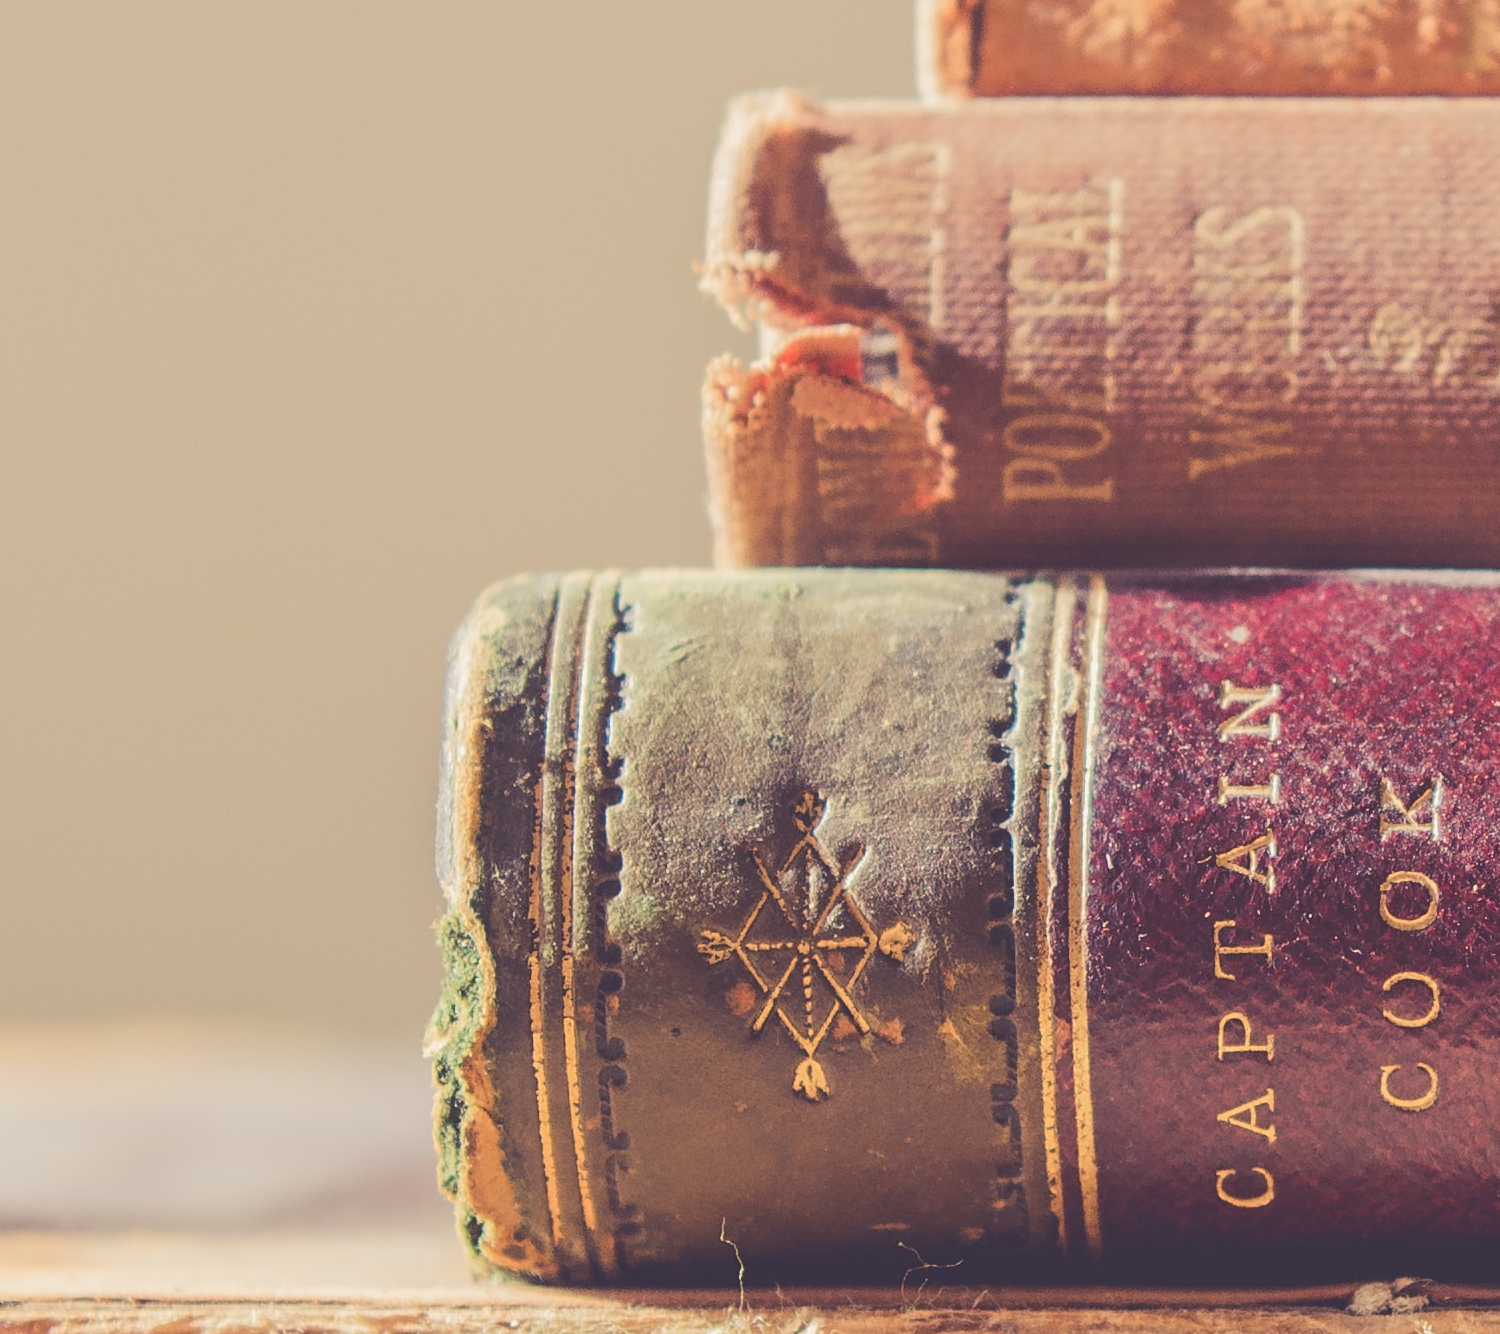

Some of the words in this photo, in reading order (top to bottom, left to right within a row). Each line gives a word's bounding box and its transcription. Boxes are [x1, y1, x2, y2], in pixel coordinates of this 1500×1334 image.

[1002, 177, 1124, 503] POETICAL
[1188, 205, 1304, 481] WORKS
[1214, 679, 1282, 1208] CAPTAIN
[1379, 774, 1443, 1112] COOK
